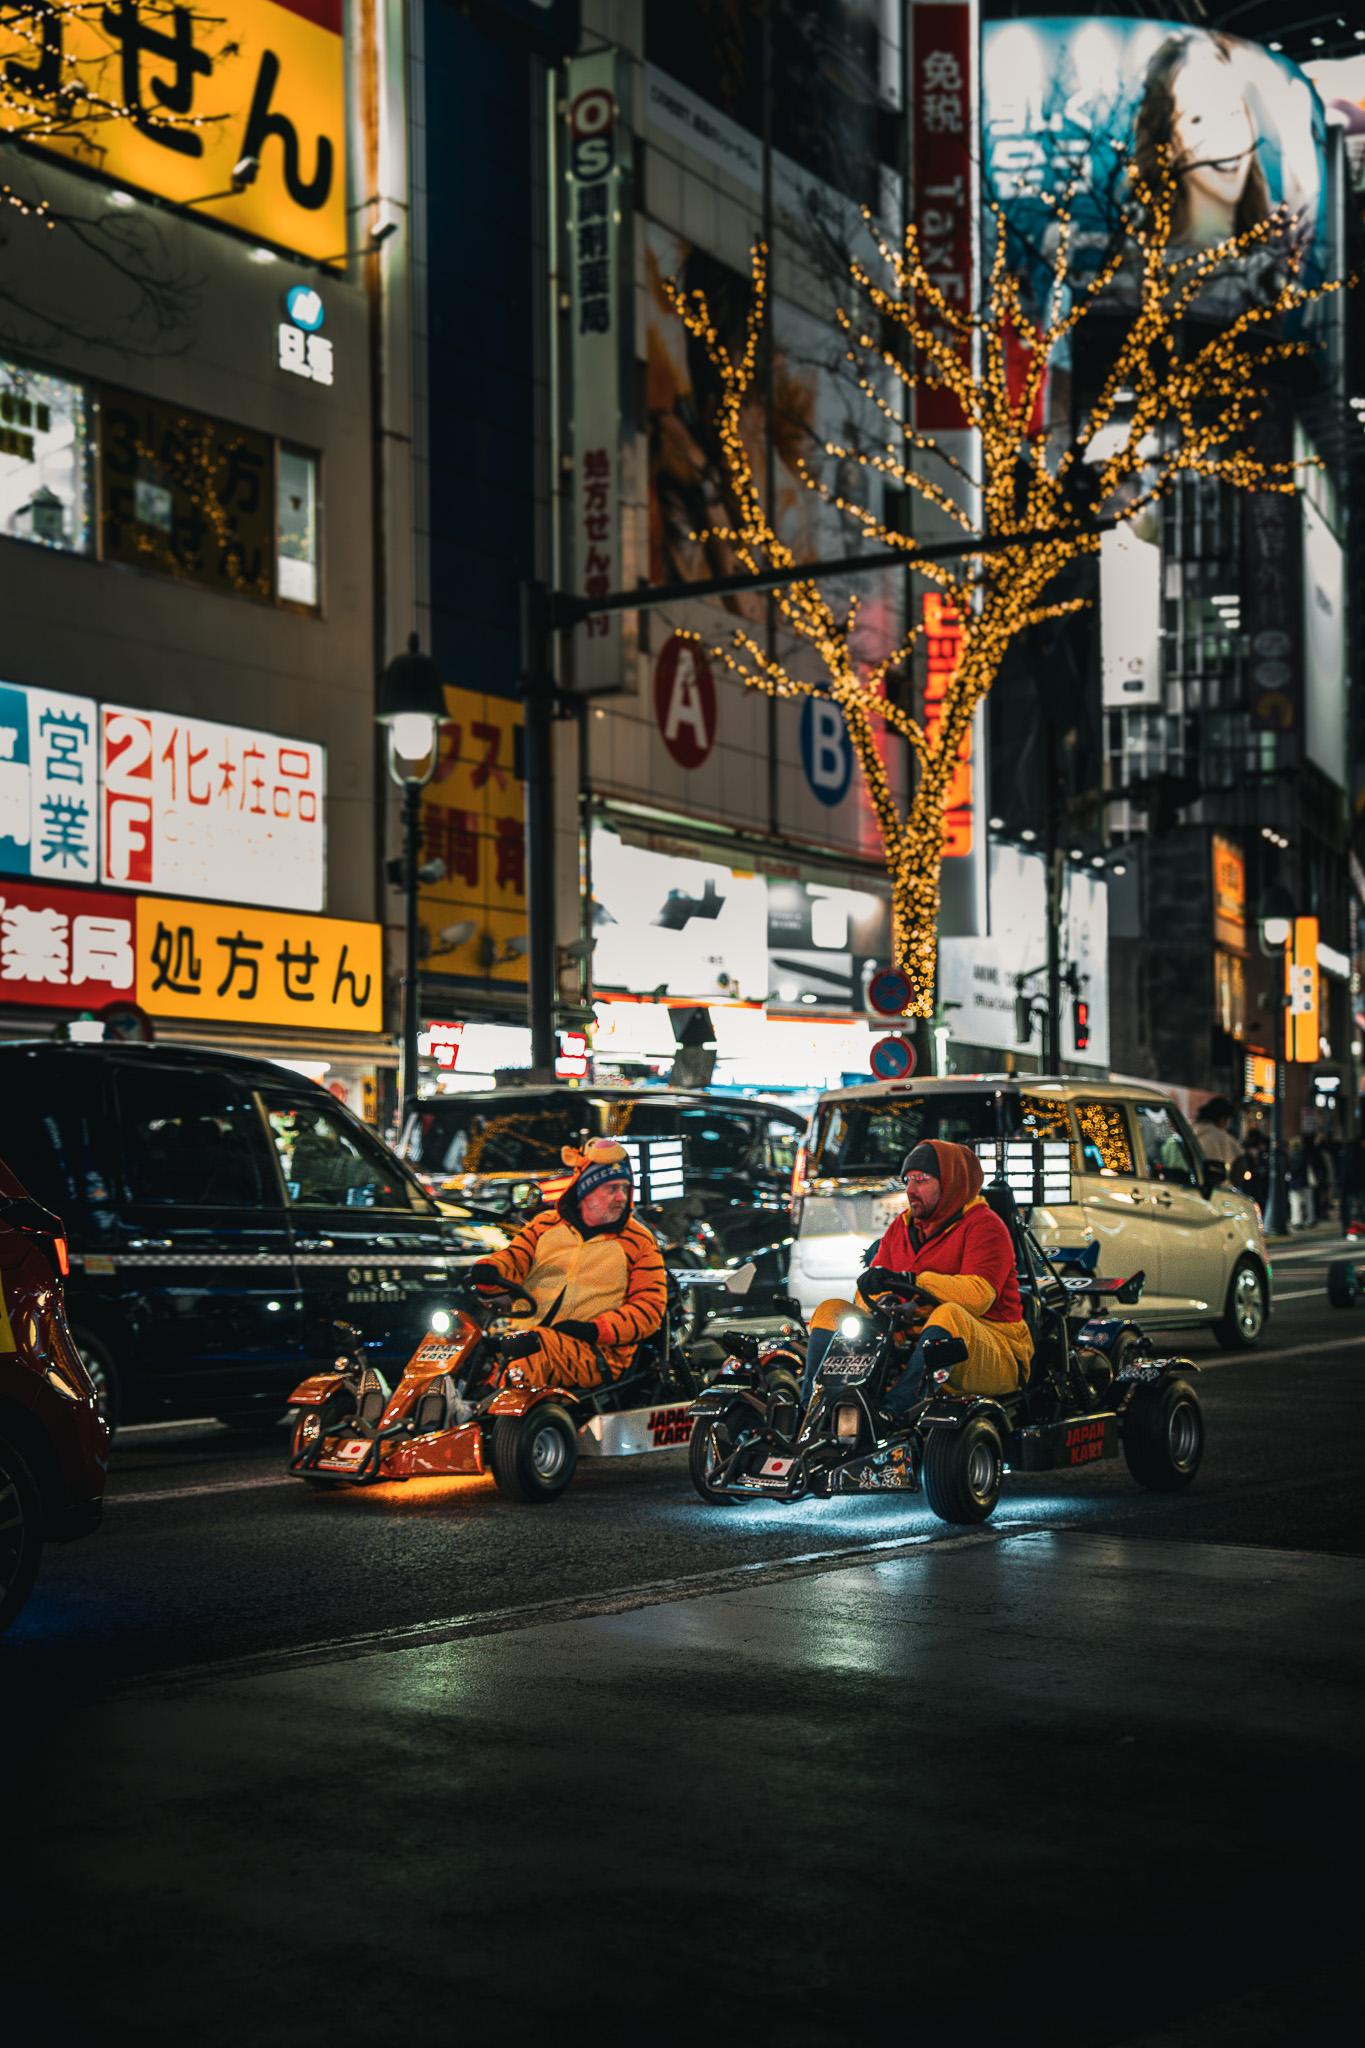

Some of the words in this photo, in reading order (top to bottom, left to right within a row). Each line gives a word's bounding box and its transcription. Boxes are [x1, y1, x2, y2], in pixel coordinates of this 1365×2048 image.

[575, 95, 610, 175] OS
[922, 50, 963, 135] 免税
[665, 646, 709, 749] A
[39, 707, 89, 869] 営業
[161, 727, 316, 823] 化粧品
[812, 699, 846, 790] B
[105, 717, 152, 881] 2F
[0, 896, 134, 990] 薬局
[150, 920, 372, 1008] 処方せん
[823, 1355, 877, 1366] JAPAN
[1065, 1422, 1105, 1448] JAPAN
[1071, 1439, 1105, 1465] KART
